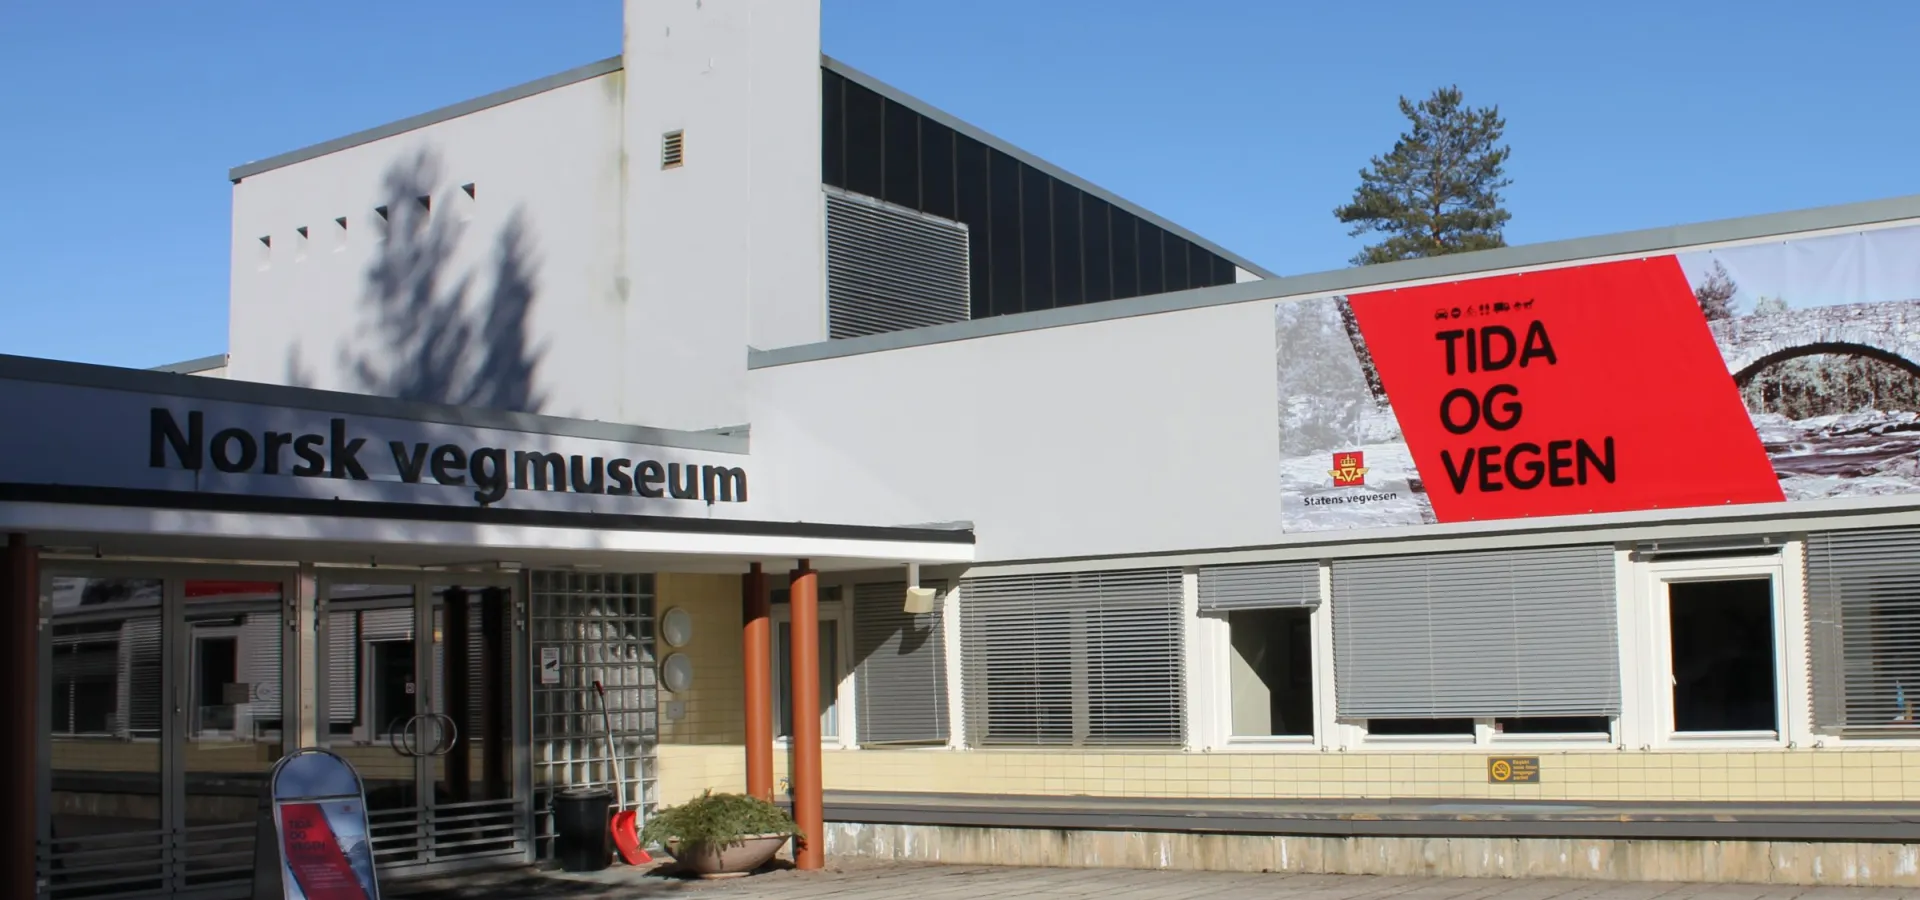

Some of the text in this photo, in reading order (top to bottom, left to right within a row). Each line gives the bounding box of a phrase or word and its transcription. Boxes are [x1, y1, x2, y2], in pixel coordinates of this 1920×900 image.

[1435, 320, 1557, 376] TIDA
[1440, 384, 1523, 435] OG
[149, 407, 748, 506] Norsk vegmuseum
[1440, 436, 1616, 495] VEGEN
[1304, 491, 1397, 507] Statens vegvesen
